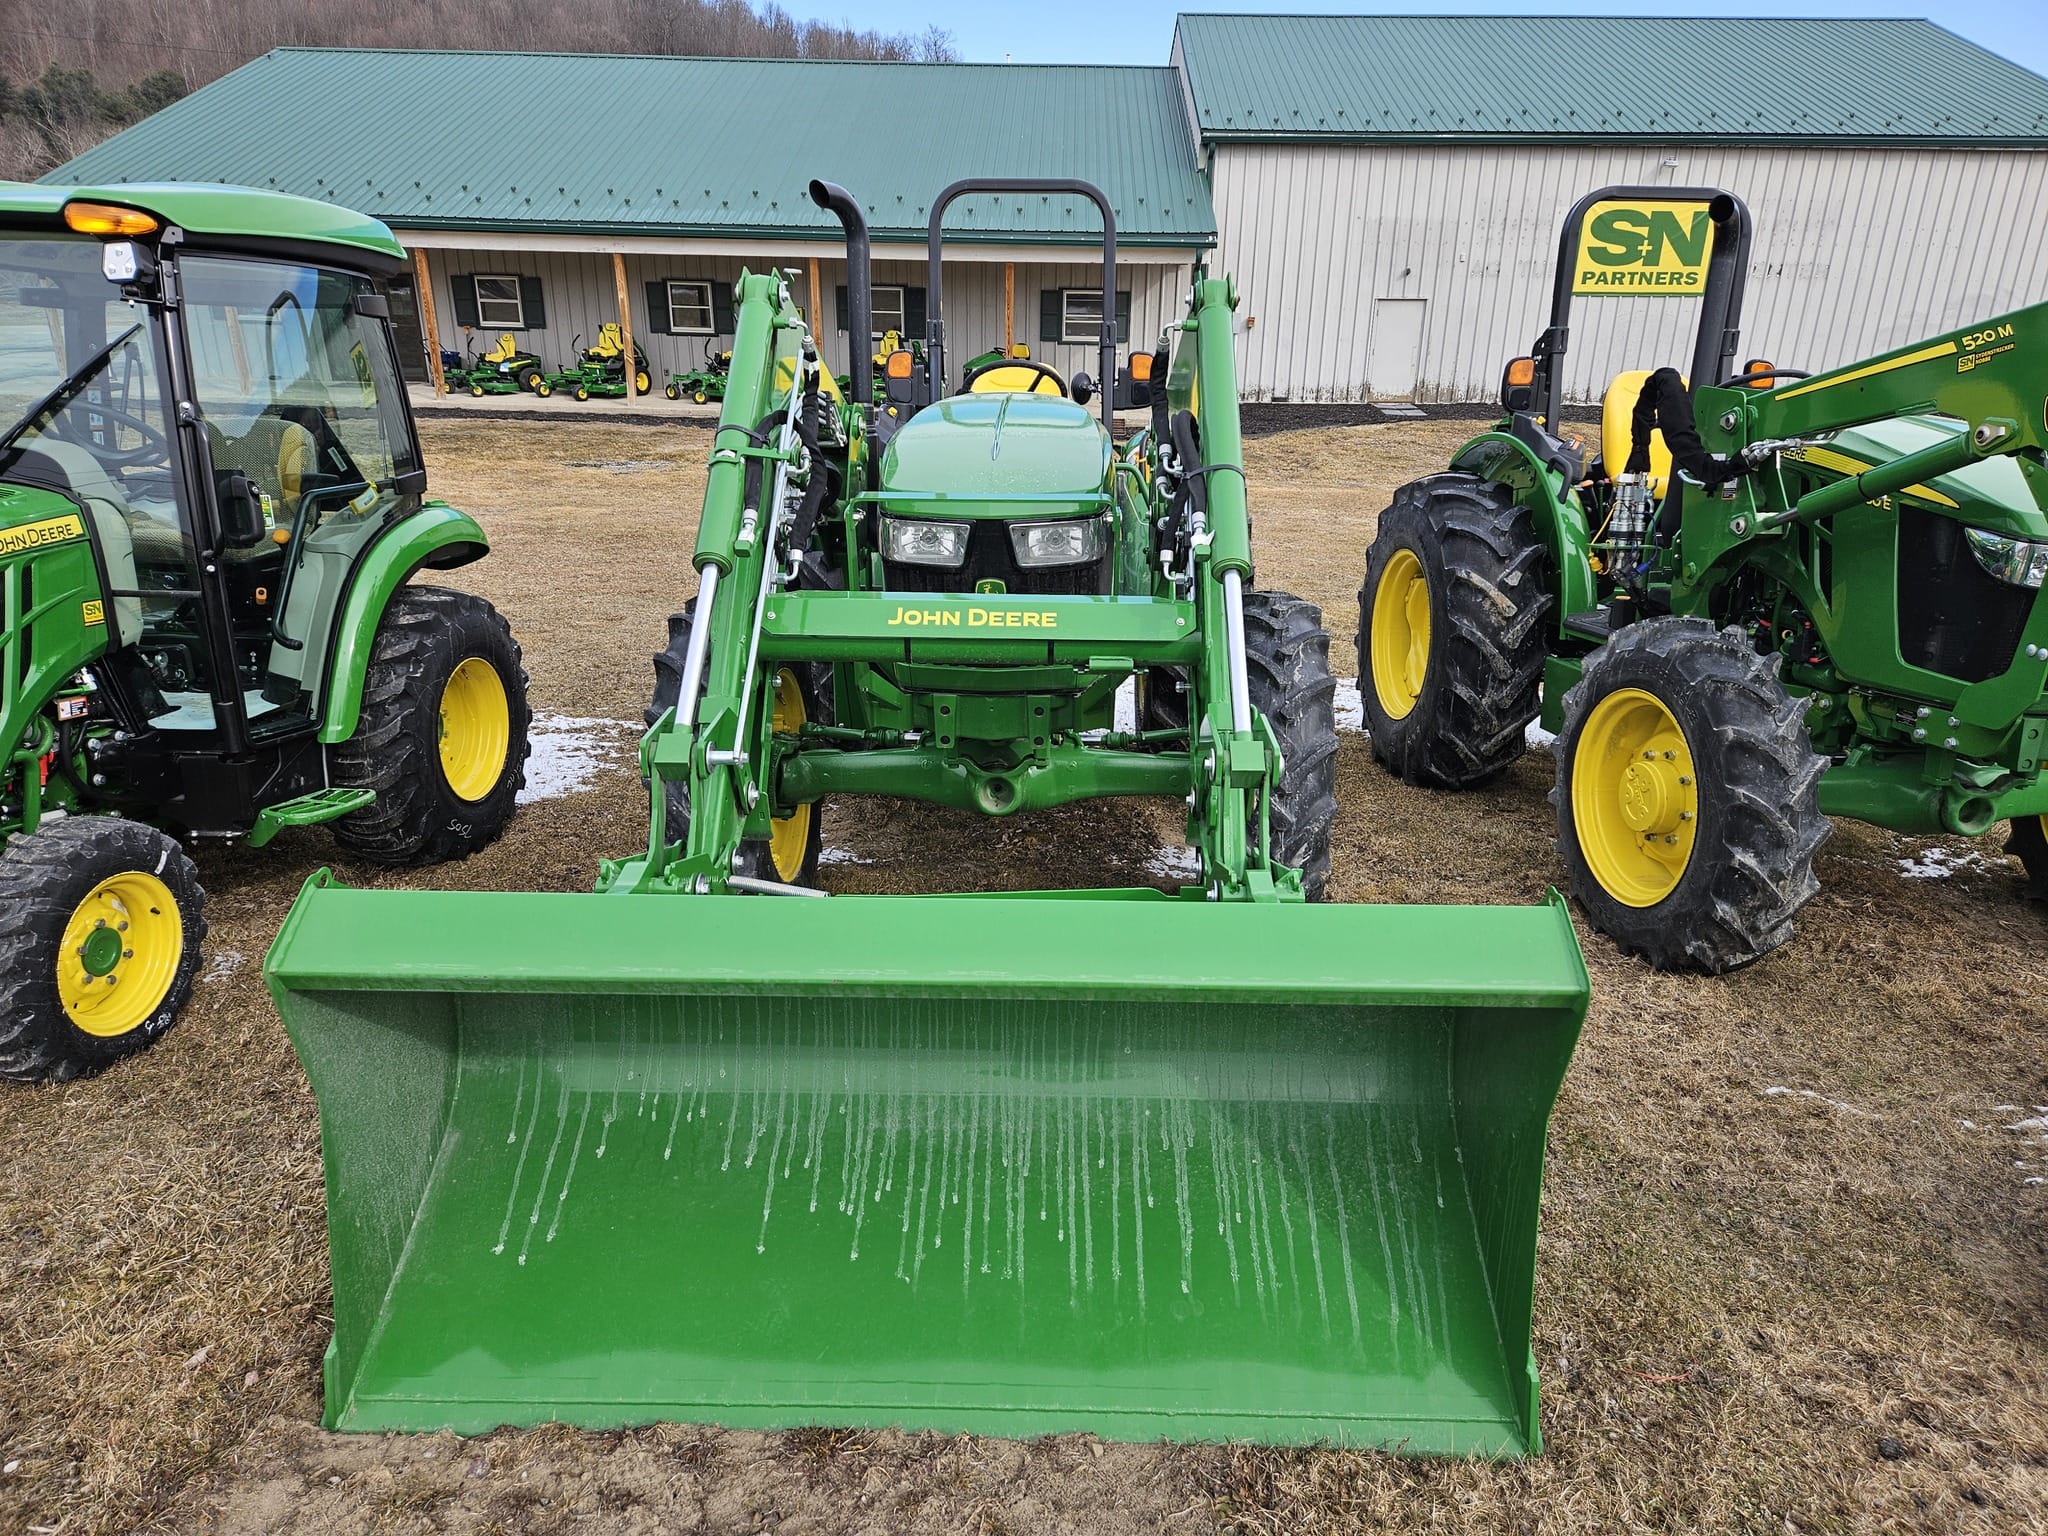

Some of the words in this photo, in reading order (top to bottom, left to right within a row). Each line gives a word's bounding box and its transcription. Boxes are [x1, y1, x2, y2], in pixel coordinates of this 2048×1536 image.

[1581, 271, 1699, 286] PARTNERS
[1961, 329, 1996, 351] 520
[27, 523, 74, 545] DEERE
[888, 607, 961, 627] JOHN
[968, 608, 1058, 628] DEERE
